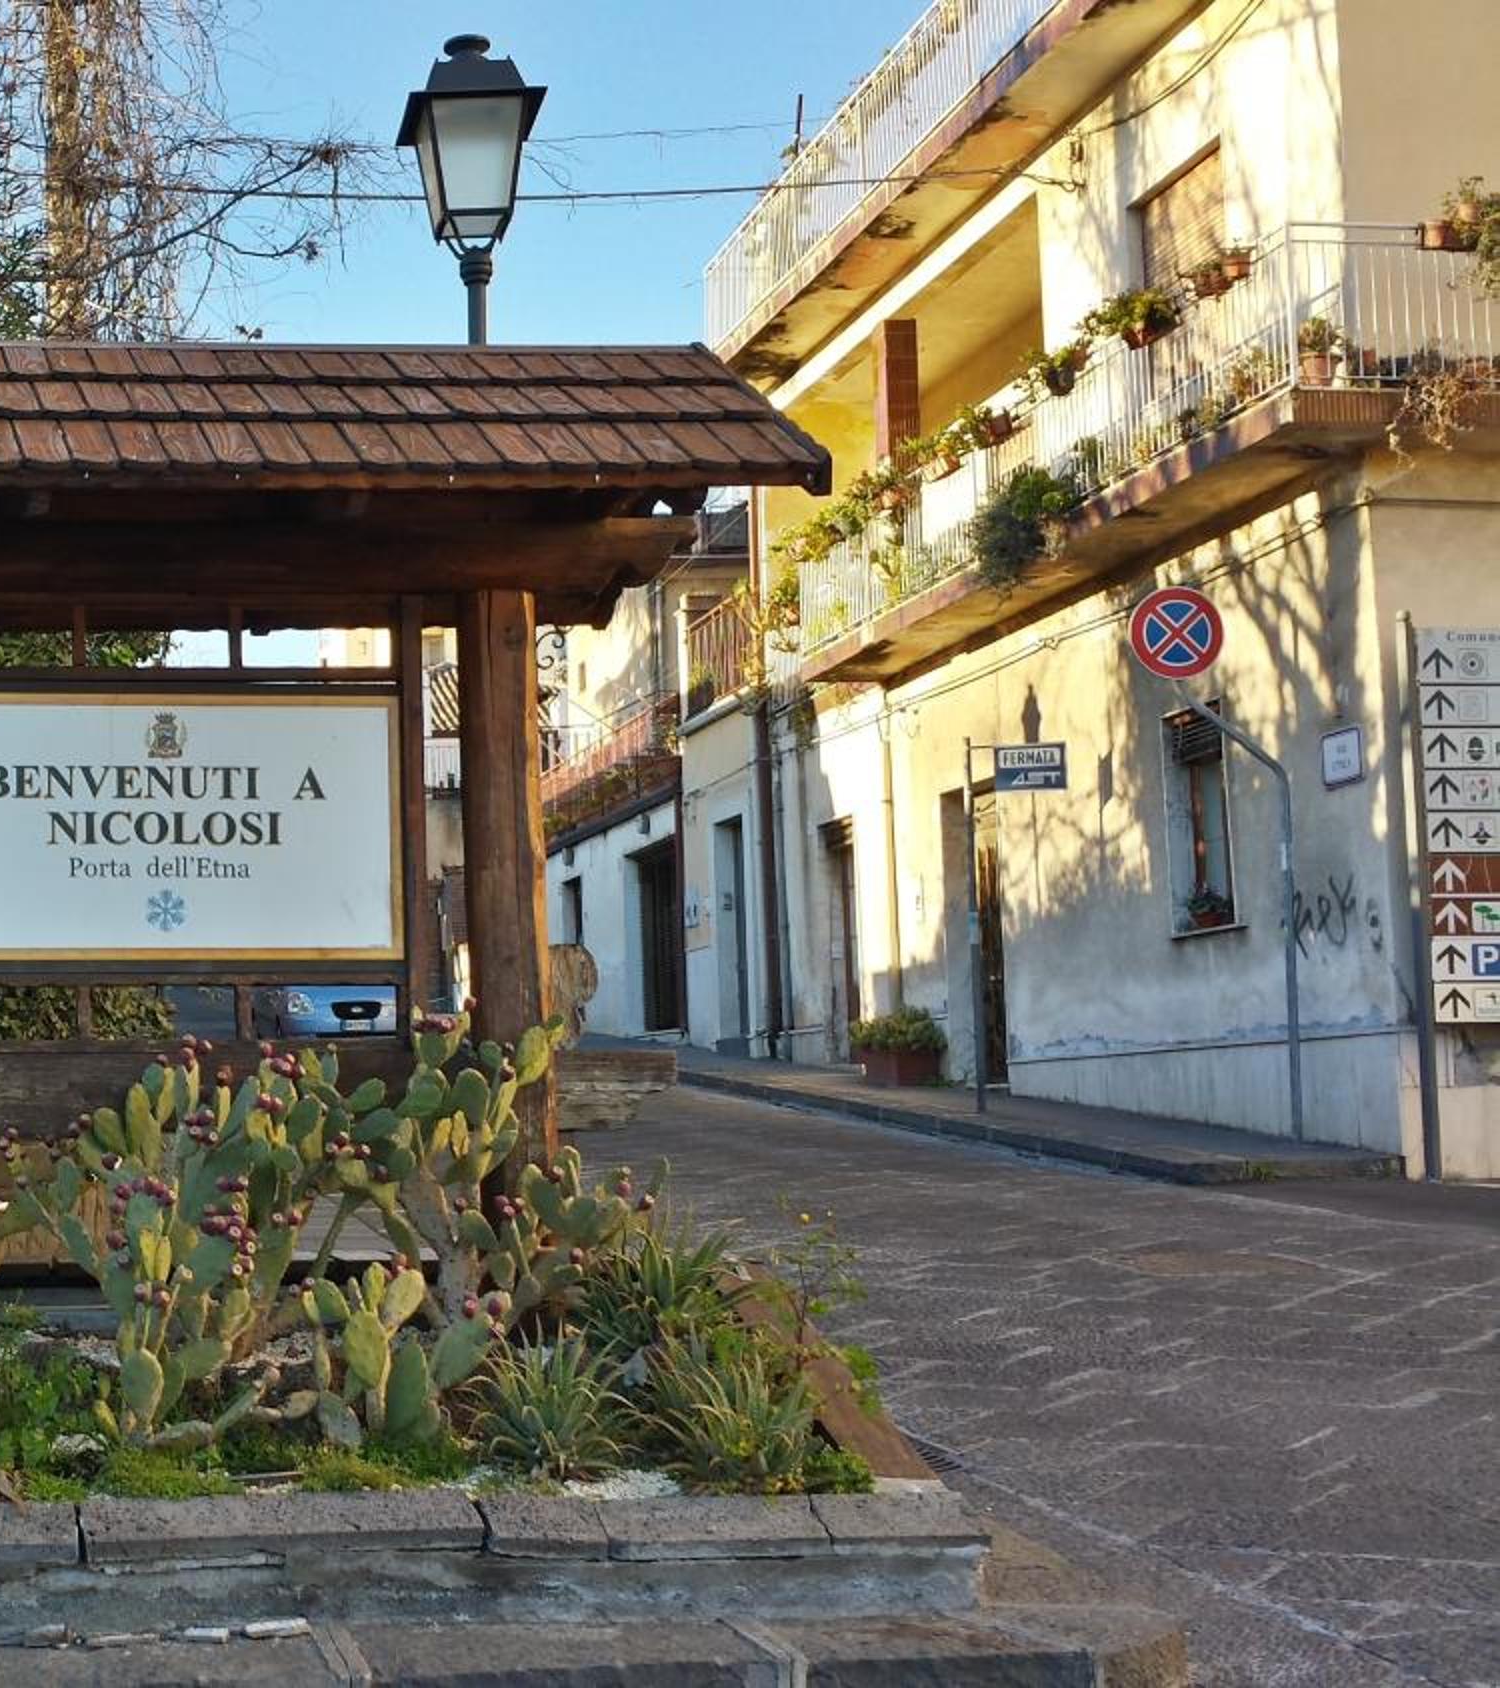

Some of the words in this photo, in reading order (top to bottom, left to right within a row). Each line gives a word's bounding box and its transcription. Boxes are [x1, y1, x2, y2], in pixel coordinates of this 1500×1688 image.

[1446, 631, 1500, 641] Comun
[1003, 750, 1057, 766] FERMATA
[294, 767, 326, 801] A
[47, 811, 281, 846] NICOLOSI
[69, 857, 132, 878] Porta
[146, 856, 250, 878] dell'Etna
[1478, 946, 1499, 973] P
